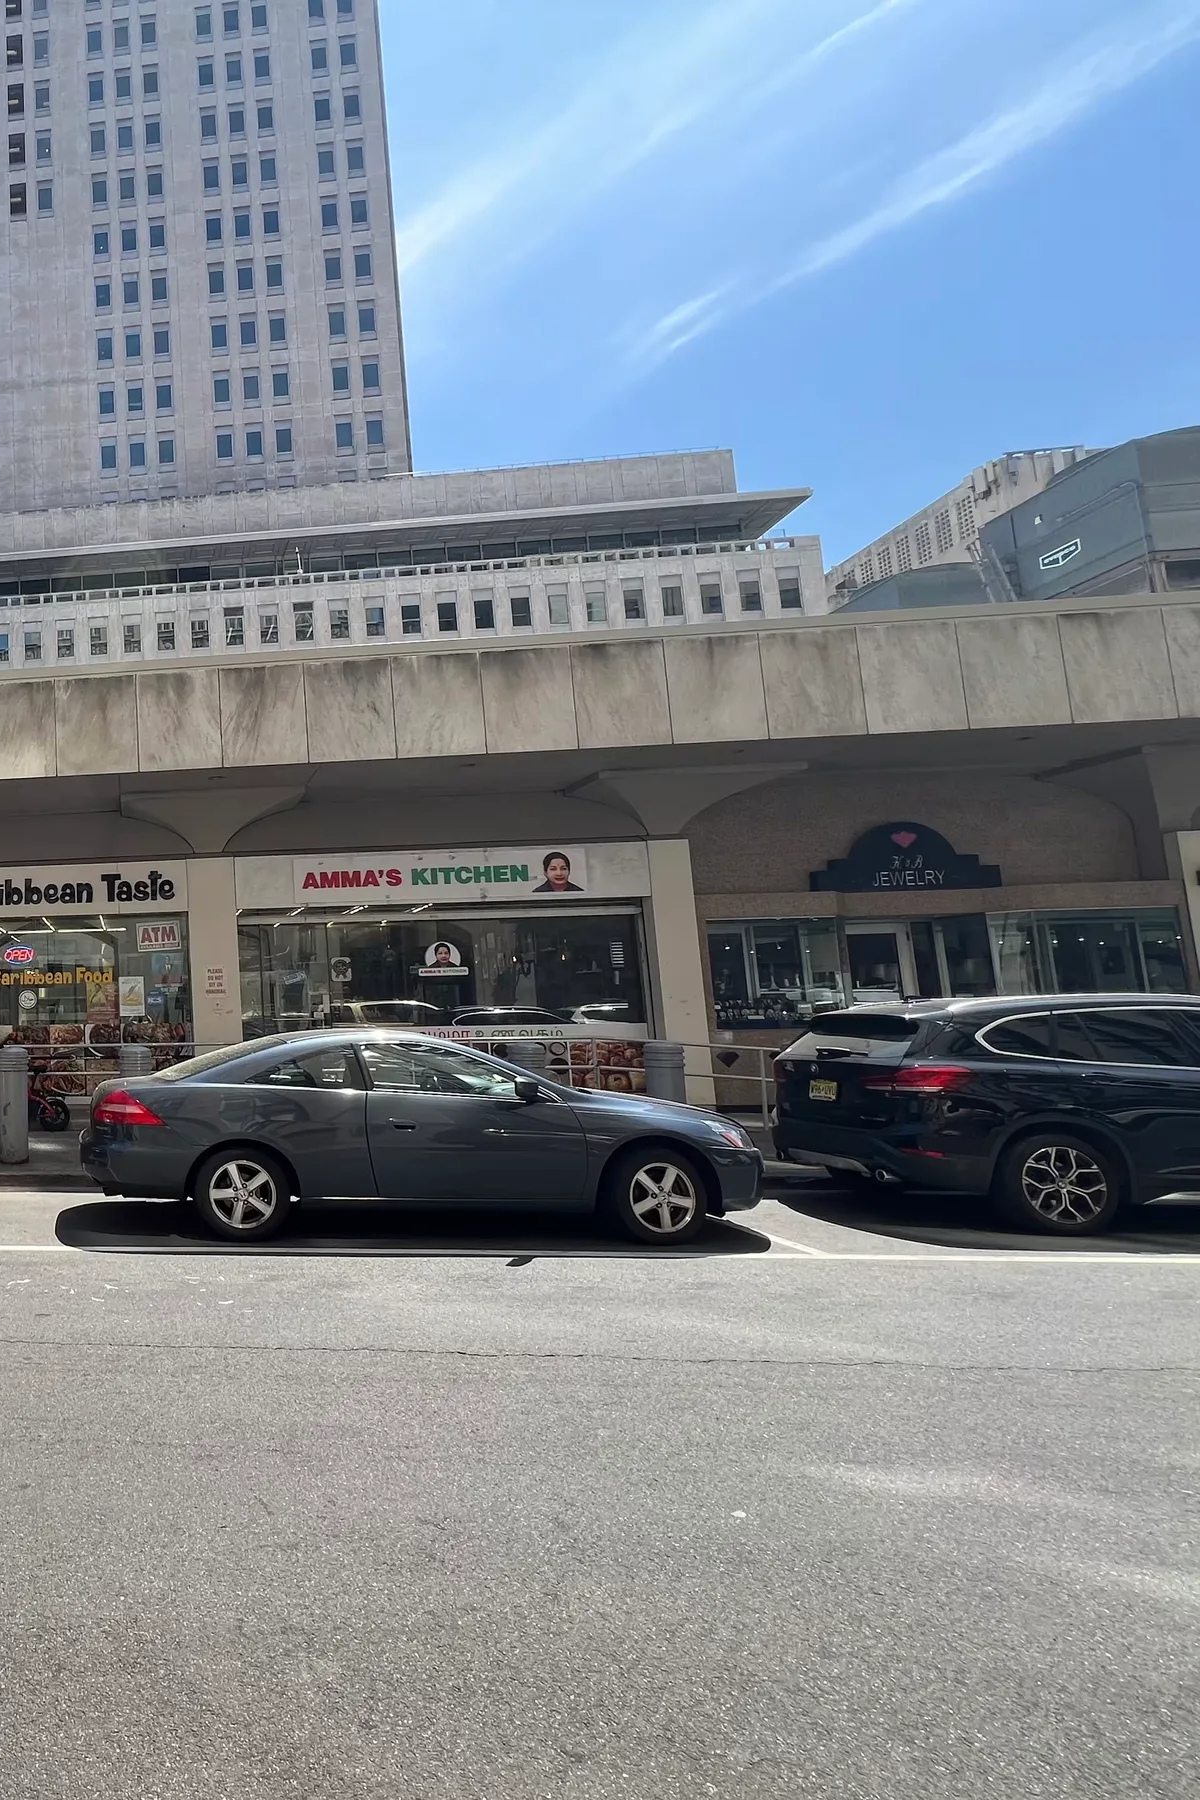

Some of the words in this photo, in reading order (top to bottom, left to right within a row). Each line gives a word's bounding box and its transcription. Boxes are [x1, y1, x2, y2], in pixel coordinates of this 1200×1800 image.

[302, 868, 403, 890] AMMA'S
[411, 864, 529, 886] KITCHEN
[873, 870, 945, 886] JEWELRY
[101, 870, 175, 902] Taste
[141, 926, 177, 943] ATM
[3, 949, 35, 961] OPEN
[75, 967, 113, 984] Food
